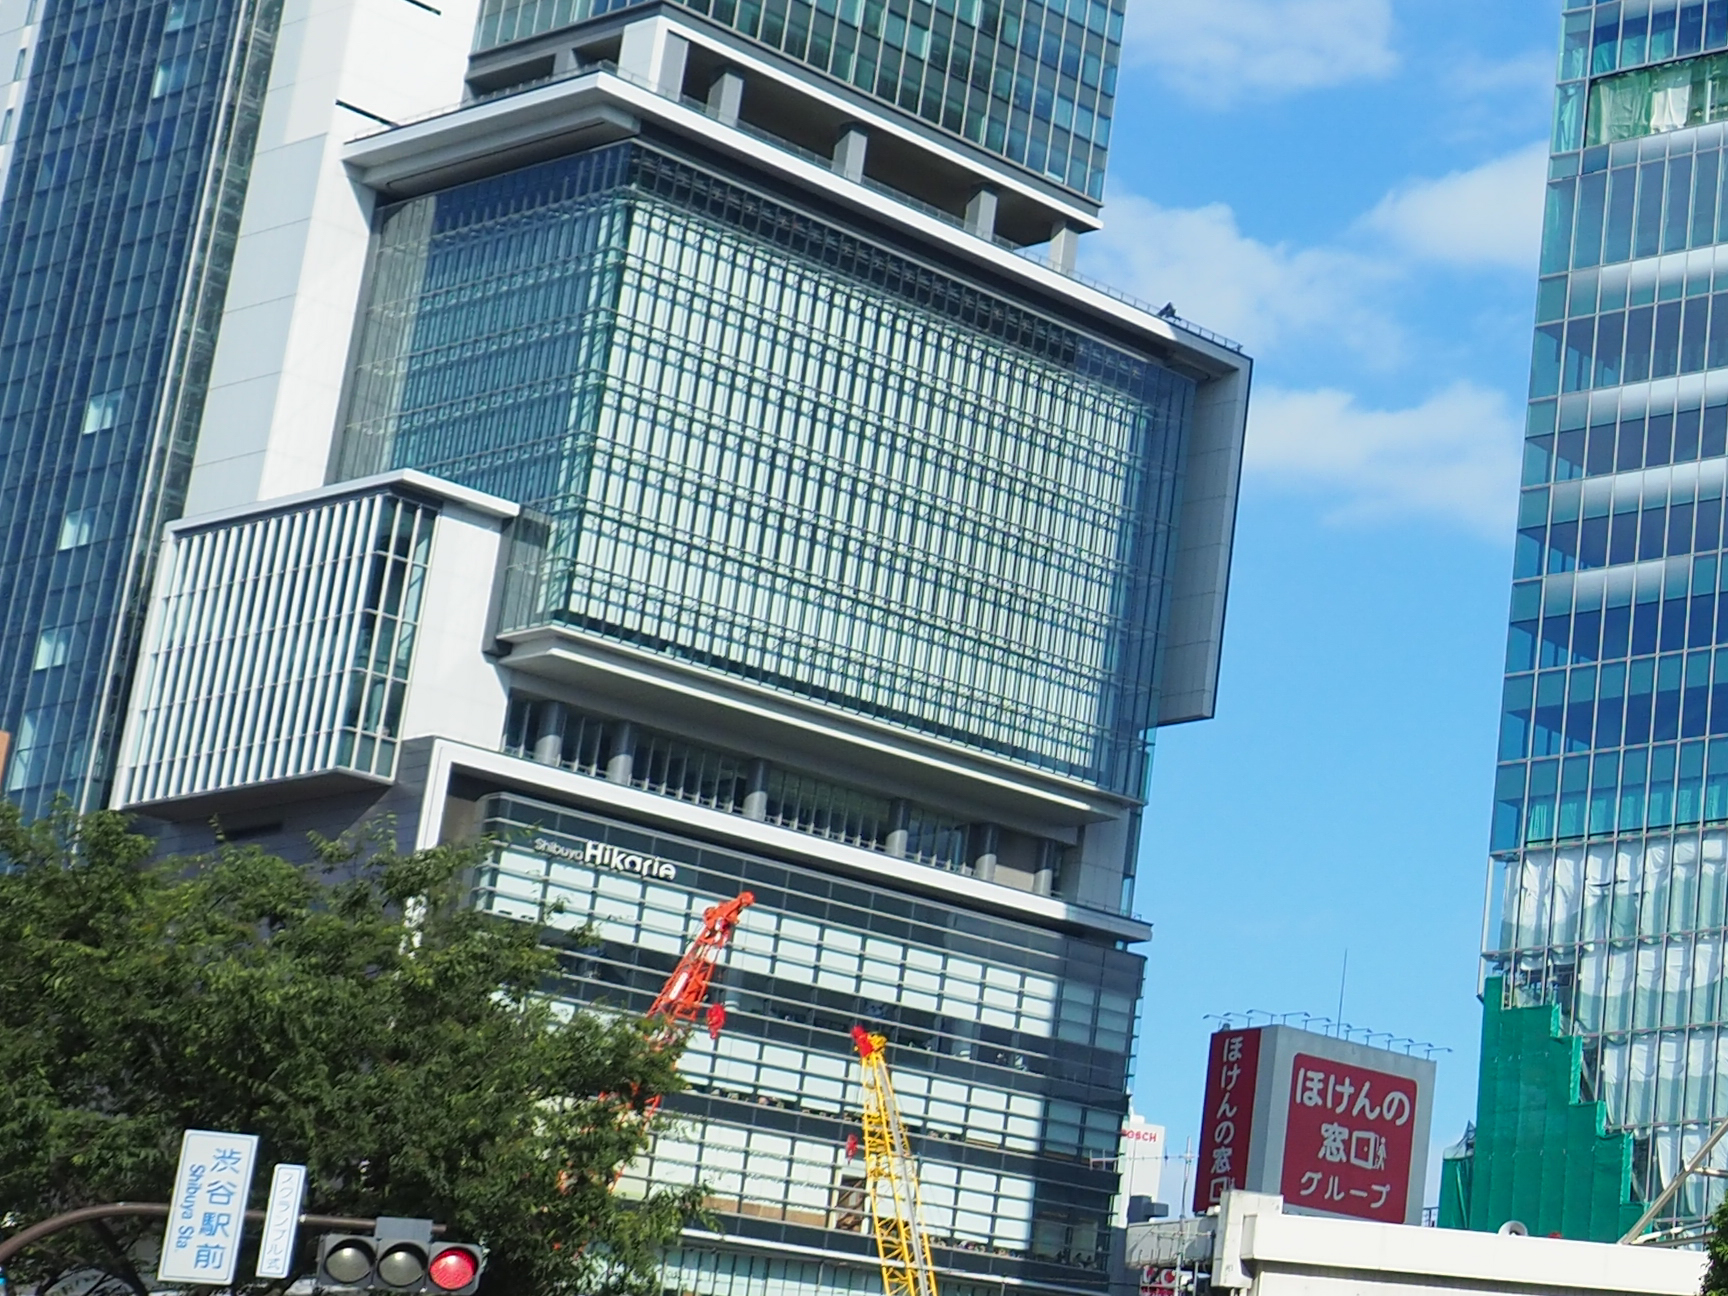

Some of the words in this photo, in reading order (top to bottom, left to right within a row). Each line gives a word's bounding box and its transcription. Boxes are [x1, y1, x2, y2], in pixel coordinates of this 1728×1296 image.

[533, 837, 585, 862] Shibuya
[584, 839, 677, 881] Hikarie
[1208, 1036, 1244, 1204] ほけんの窓口
[1295, 1067, 1411, 1126] ほけんの
[180, 1163, 206, 1220] Shibuya
[193, 1148, 243, 1270] 渋谷駅前
[1299, 1170, 1391, 1209] グループ
